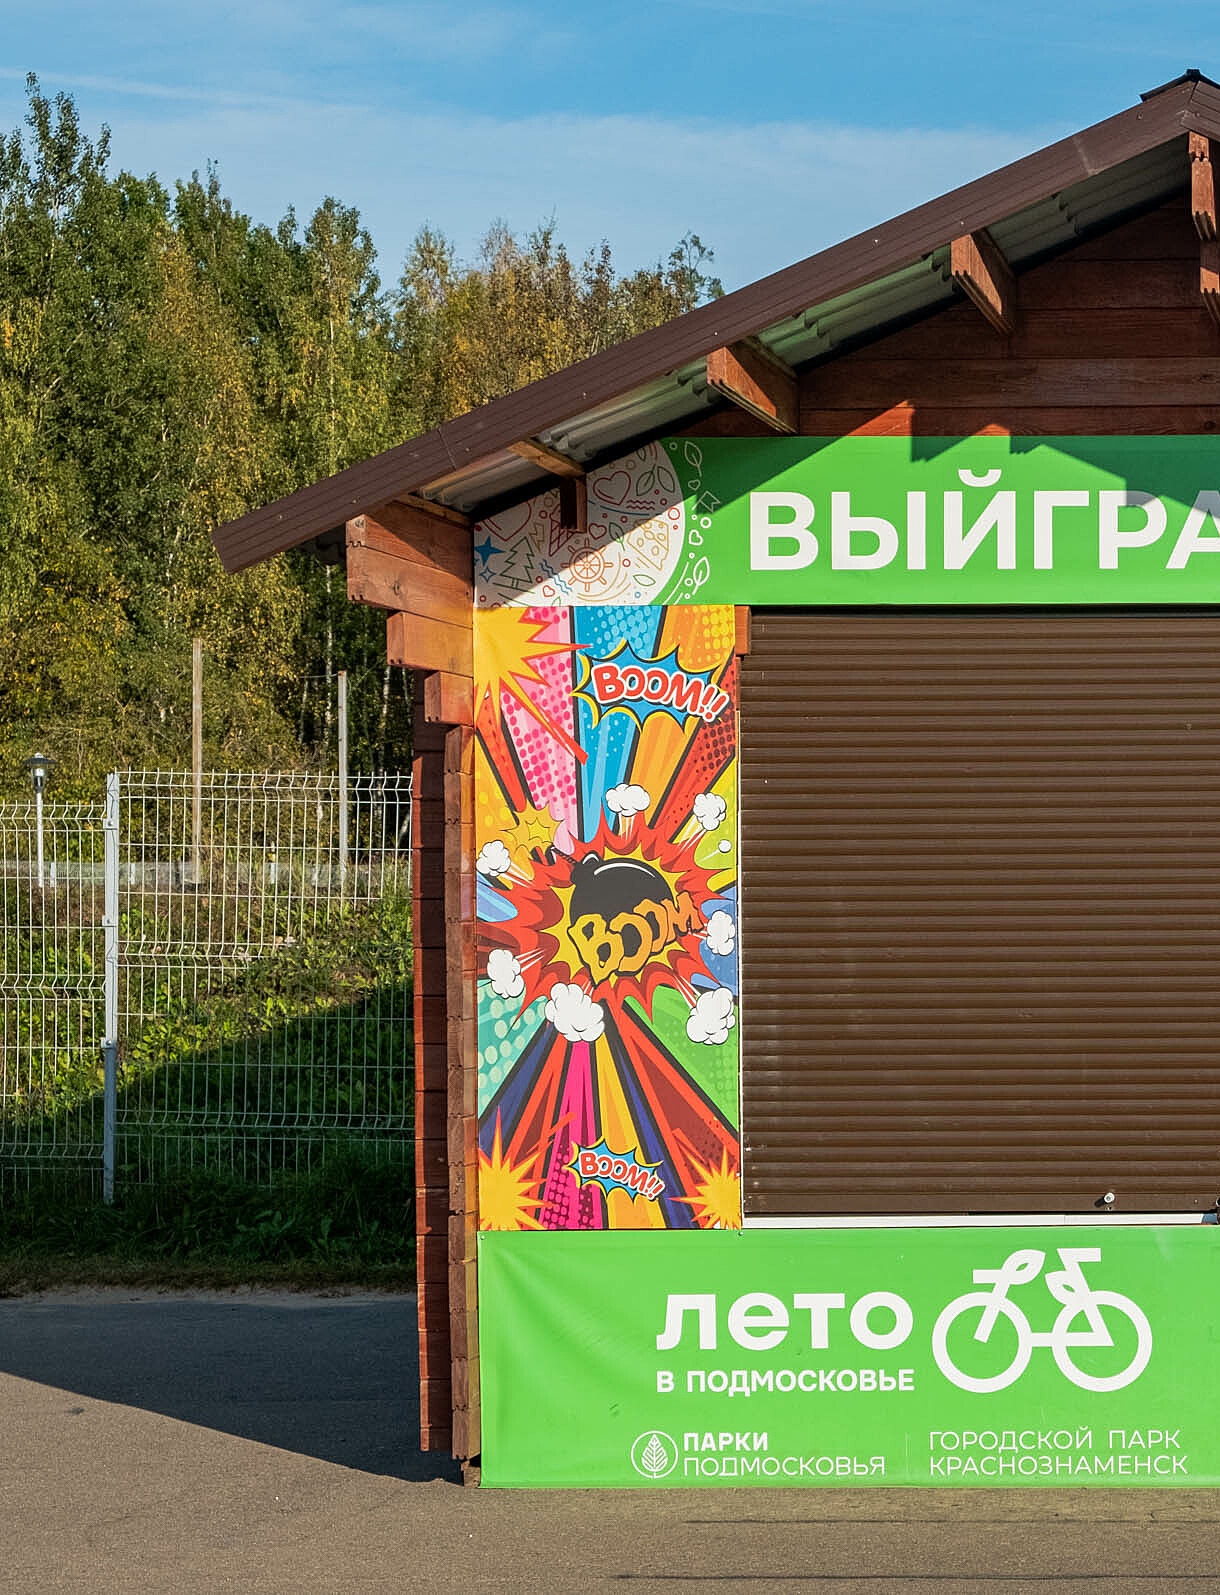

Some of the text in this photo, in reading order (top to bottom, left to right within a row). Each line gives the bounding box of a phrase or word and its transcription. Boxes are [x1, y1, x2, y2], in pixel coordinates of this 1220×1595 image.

[592, 664, 729, 722] BOOM!!
[567, 890, 705, 987] BOOM
[578, 1151, 665, 1200] BOOM!!
[656, 1369, 915, 1397] В ПОДМОСКОВЬЕ
[683, 1431, 769, 1452] ПАРКИ
[929, 1425, 1180, 1453] ГОРОДСКОЙ ПАРК
[683, 1455, 885, 1477] ПОДМОСКОВЬЯ
[929, 1455, 1188, 1476] КРАСНОЗНАМЕНСК
